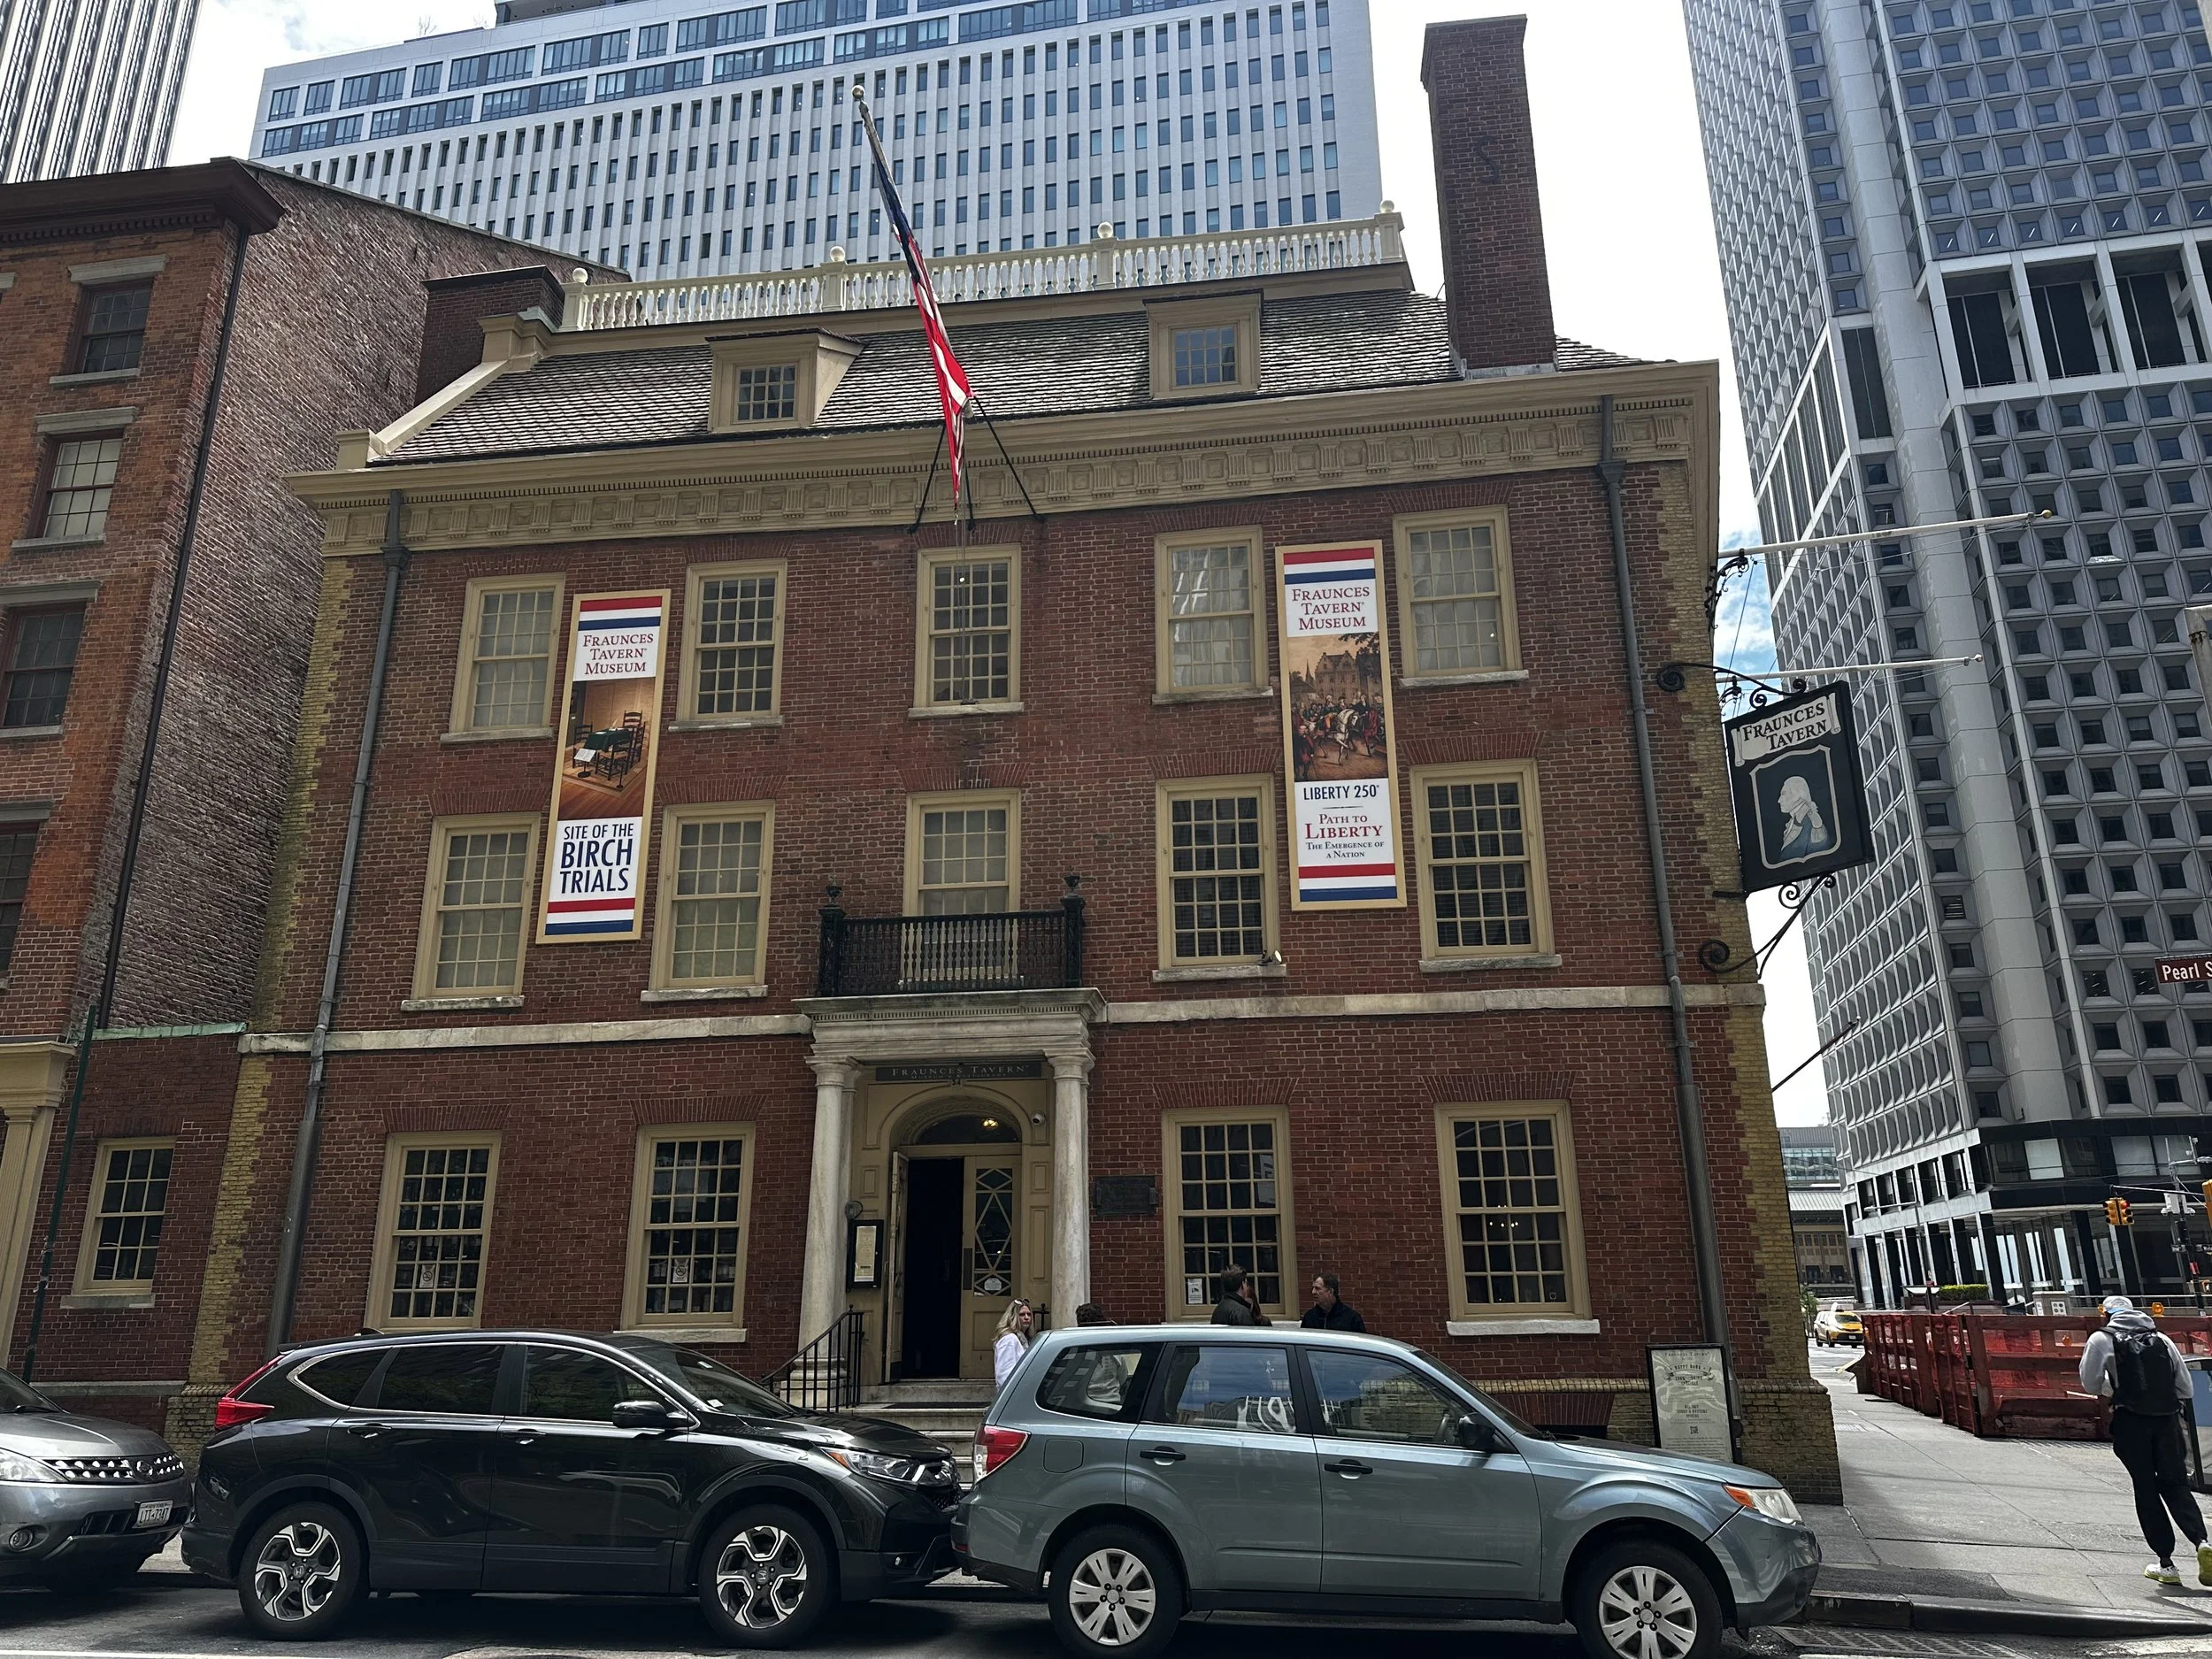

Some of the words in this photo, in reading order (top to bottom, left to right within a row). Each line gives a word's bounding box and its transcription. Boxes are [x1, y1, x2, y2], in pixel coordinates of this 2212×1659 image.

[1292, 586, 1371, 602] FRAUNCES
[1299, 616, 1366, 631] MUSEUM
[582, 633, 654, 647] FRAUNCES
[584, 662, 646, 675] MUSEUM
[1742, 702, 1825, 741] FRAUNCES
[1766, 719, 1827, 750] TAVERN
[1303, 785, 1350, 801] LIBERTY
[1319, 813, 1349, 825] PATH
[564, 825, 588, 840] SITE
[592, 824, 609, 839] OF
[612, 823, 634, 837] THE
[1304, 823, 1383, 840] LIBERTY
[1305, 841, 1323, 850] THE
[1325, 841, 1372, 849] EMERGENCE
[560, 839, 634, 869] BIRCH
[559, 867, 629, 894] TRIALS
[2162, 962, 2200, 980] Pearl
[2205, 961, 2212, 978] S
[892, 1067, 964, 1076] FRAUNCES
